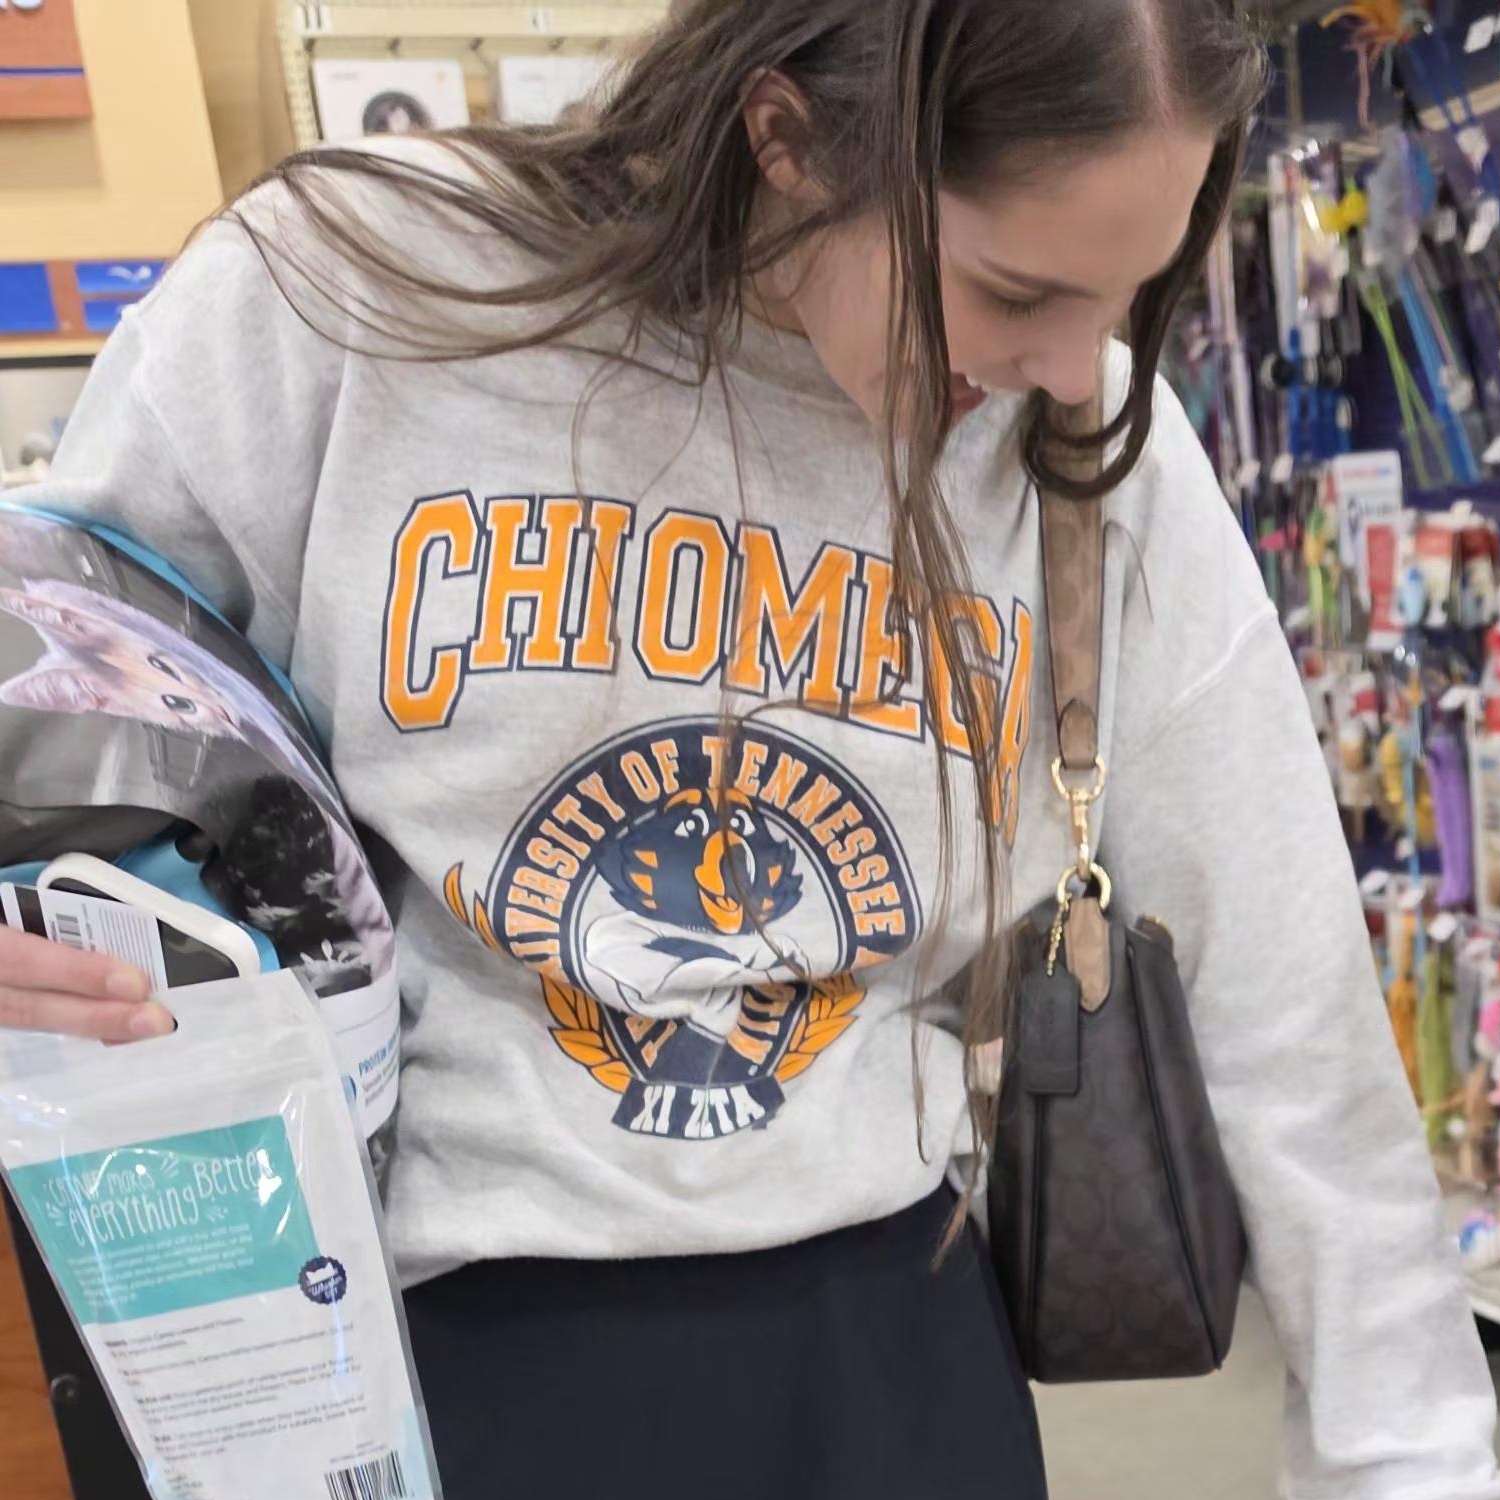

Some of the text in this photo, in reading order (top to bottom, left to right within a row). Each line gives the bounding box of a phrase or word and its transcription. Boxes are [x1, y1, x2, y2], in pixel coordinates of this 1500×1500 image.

[503, 734, 907, 984] IVERSITY OF TENNESSEE
[629, 1084, 677, 1135] XI
